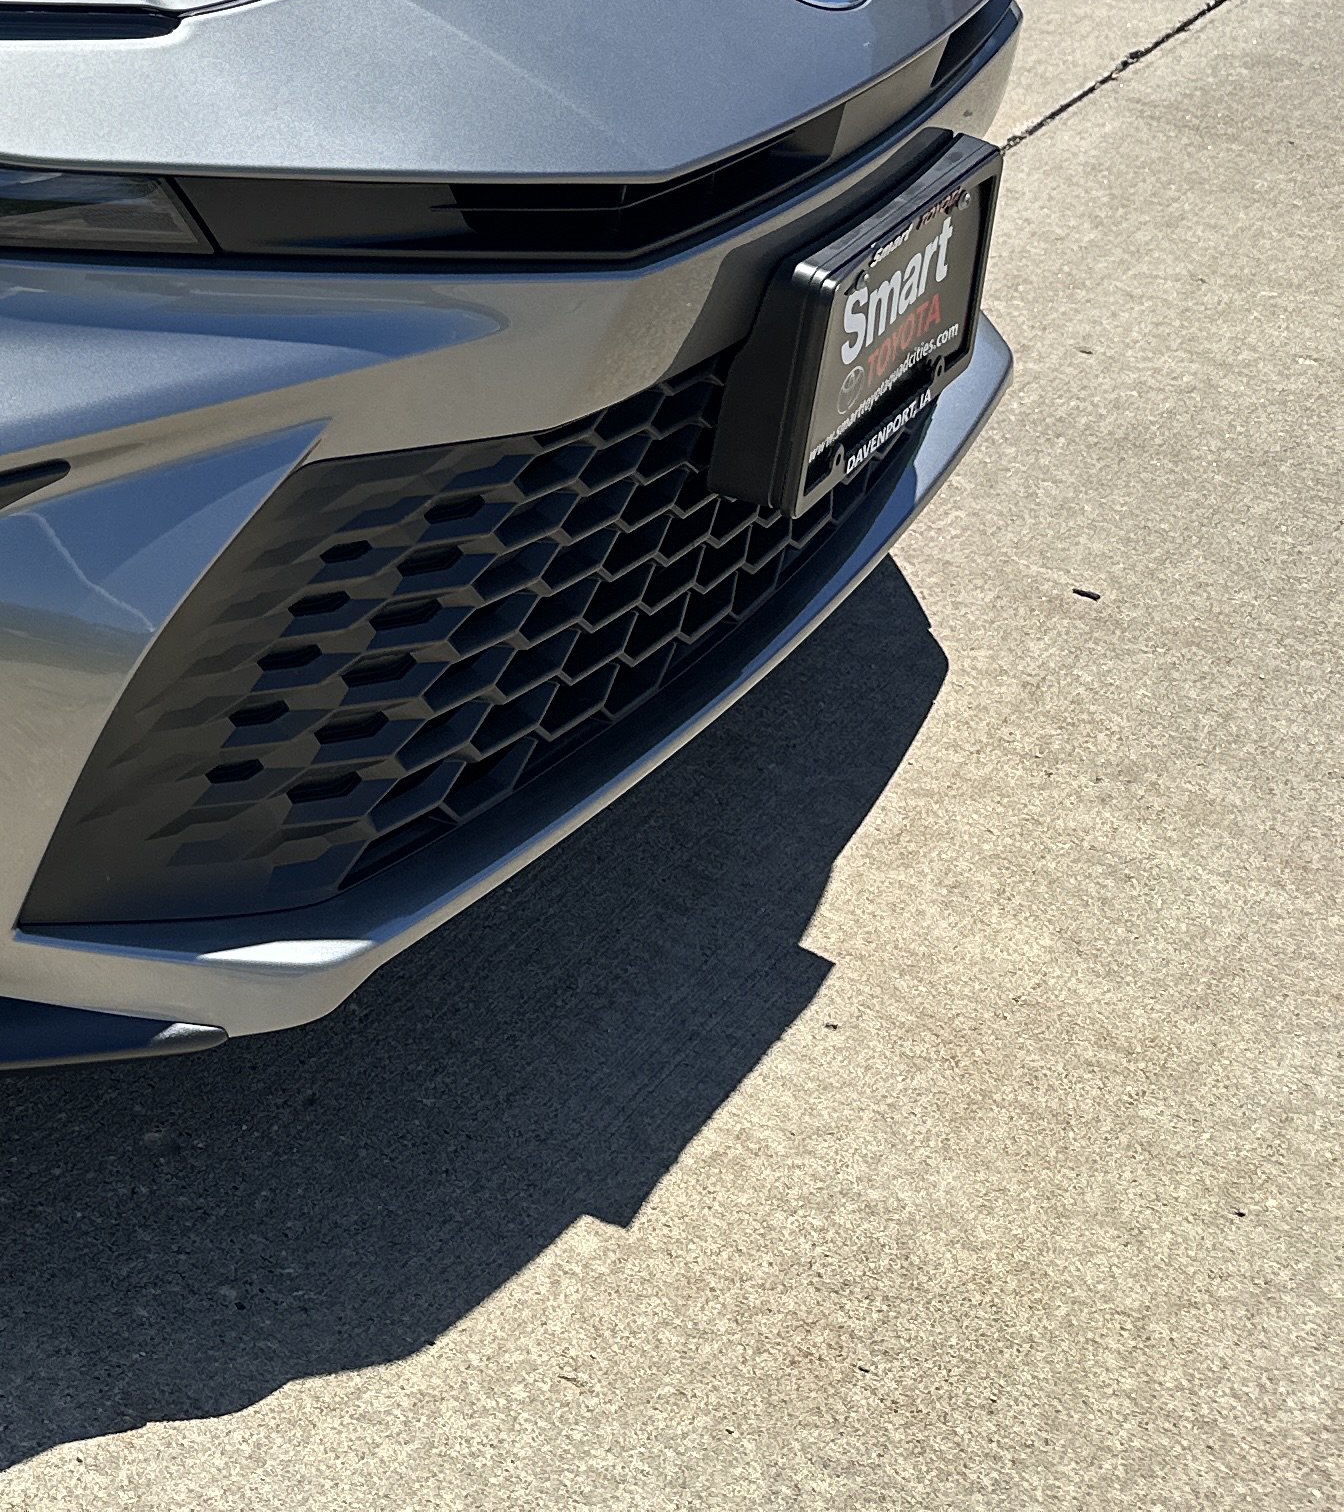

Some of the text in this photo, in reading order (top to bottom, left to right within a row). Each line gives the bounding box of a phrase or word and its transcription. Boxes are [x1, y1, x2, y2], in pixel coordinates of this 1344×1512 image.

[841, 216, 953, 365] Smart
[870, 223, 914, 268] Smart
[867, 293, 942, 386] TOYOTA
[808, 323, 959, 464] www.smarttoyotaquadcities.com
[847, 389, 932, 474] DAVENPORT, IA
